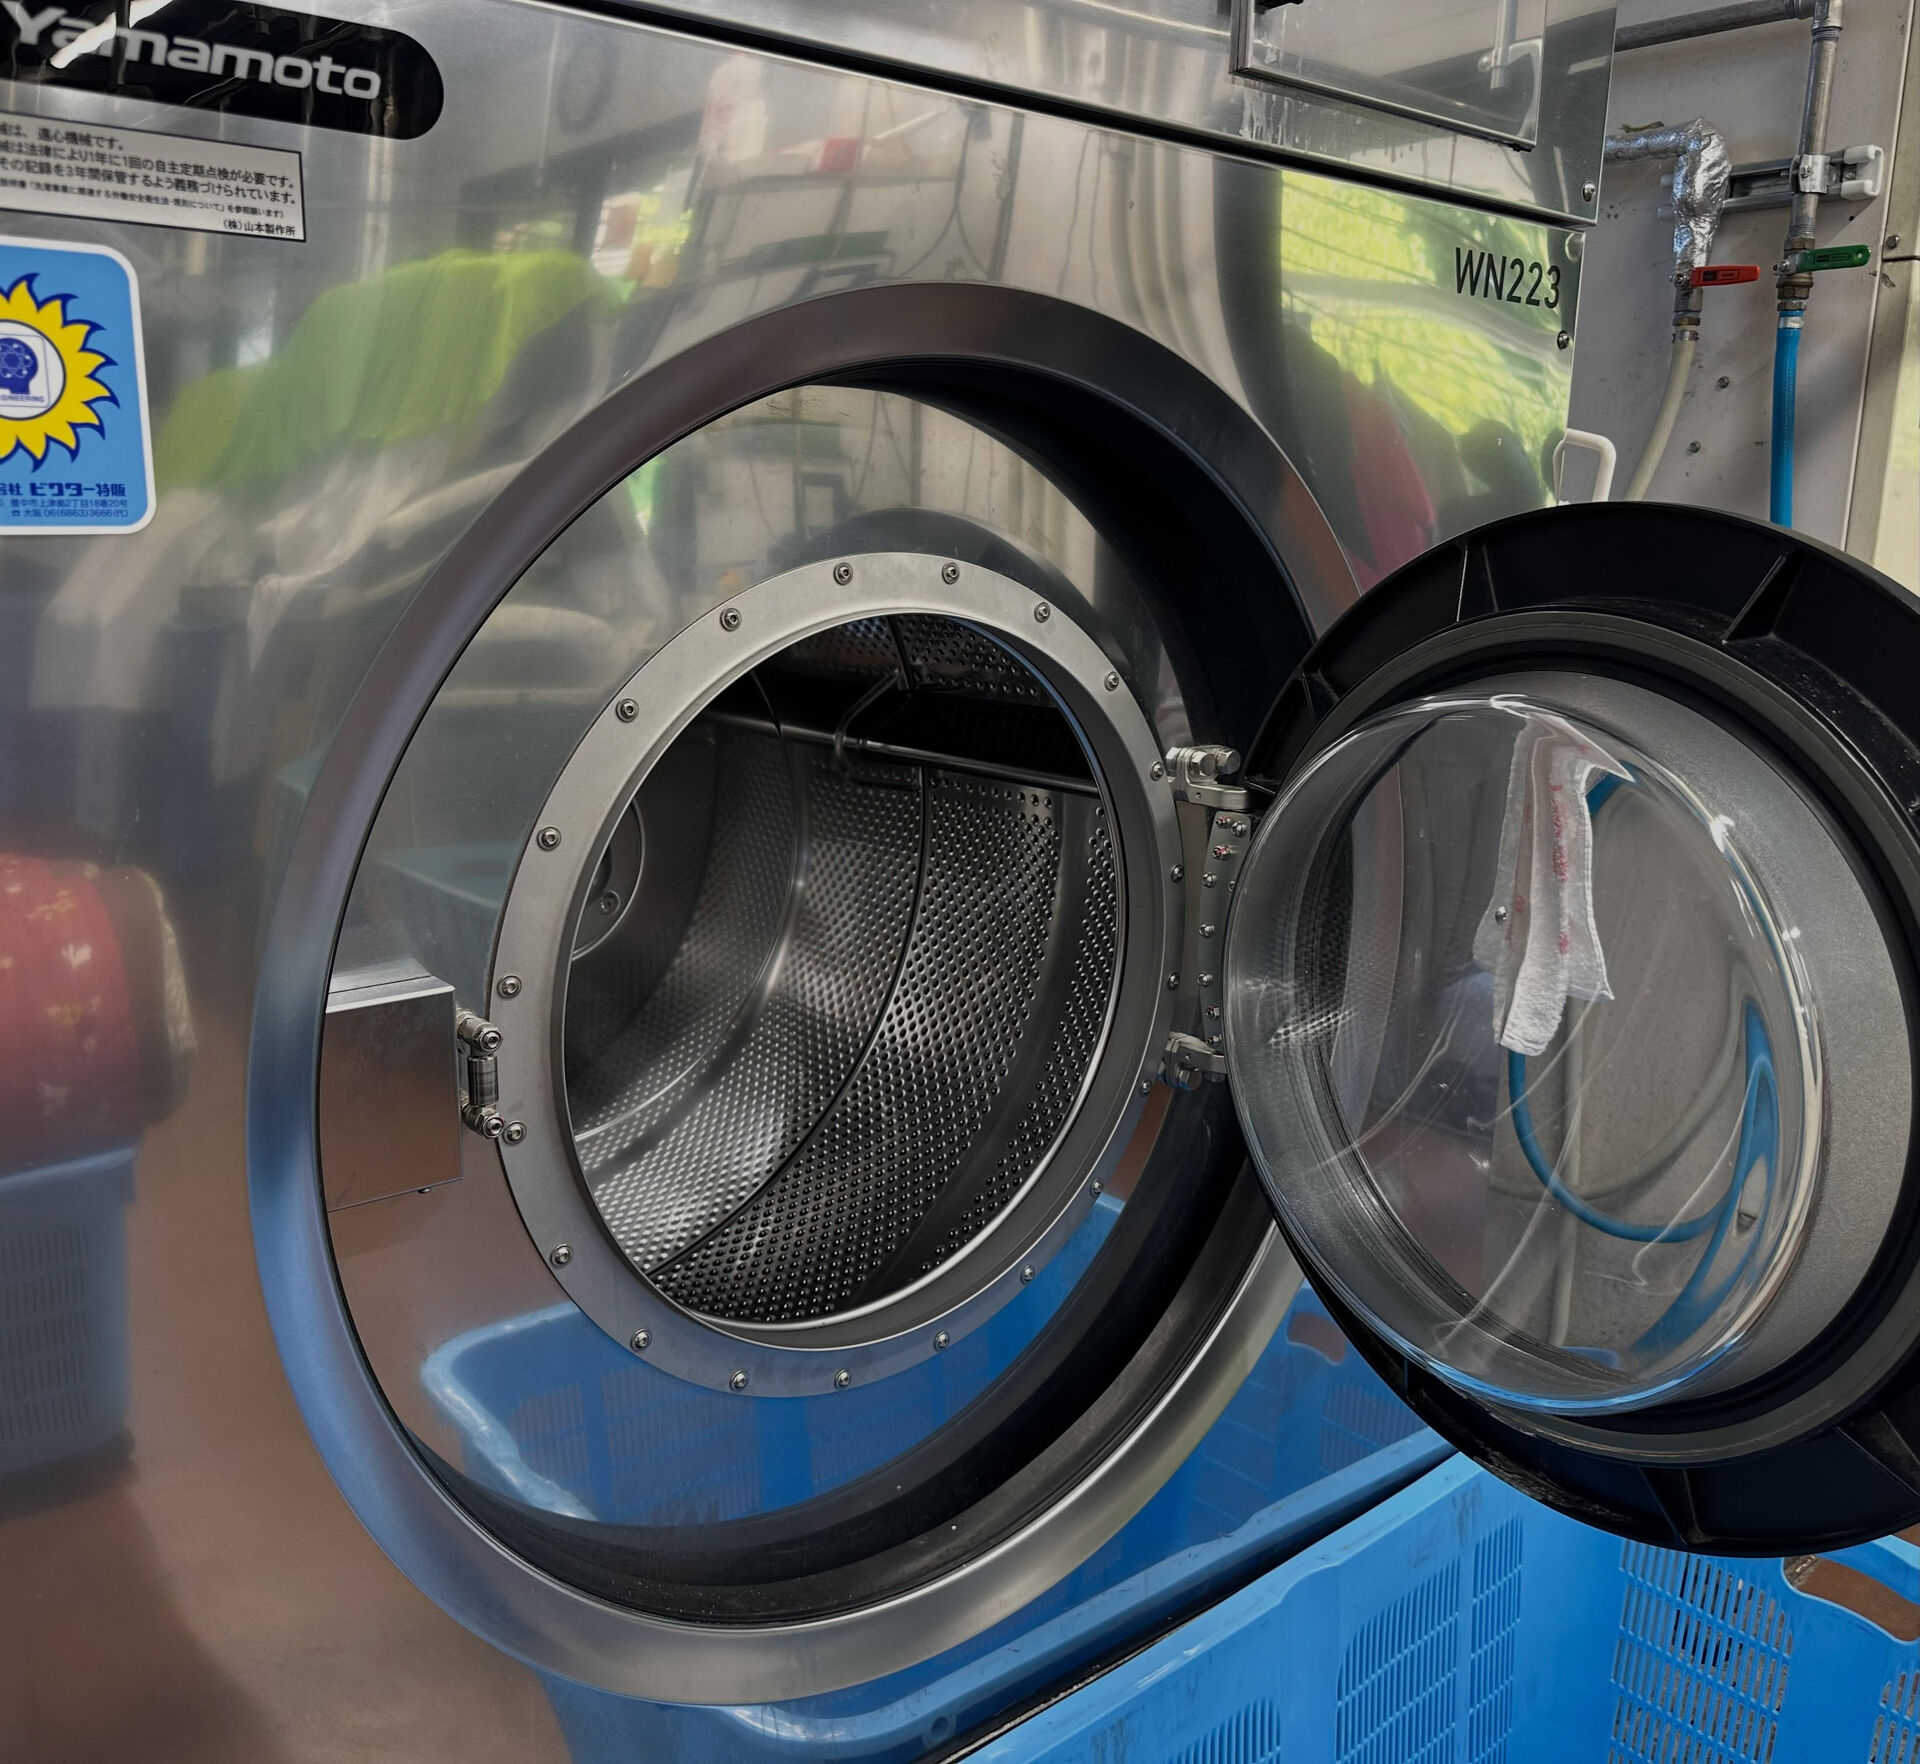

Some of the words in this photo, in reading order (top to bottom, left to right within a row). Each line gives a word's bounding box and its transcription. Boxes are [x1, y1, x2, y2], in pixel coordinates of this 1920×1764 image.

[2, 0, 381, 100] Yamamoto
[1455, 246, 1561, 309] WN223
[29, 481, 126, 497] ビクター特販
